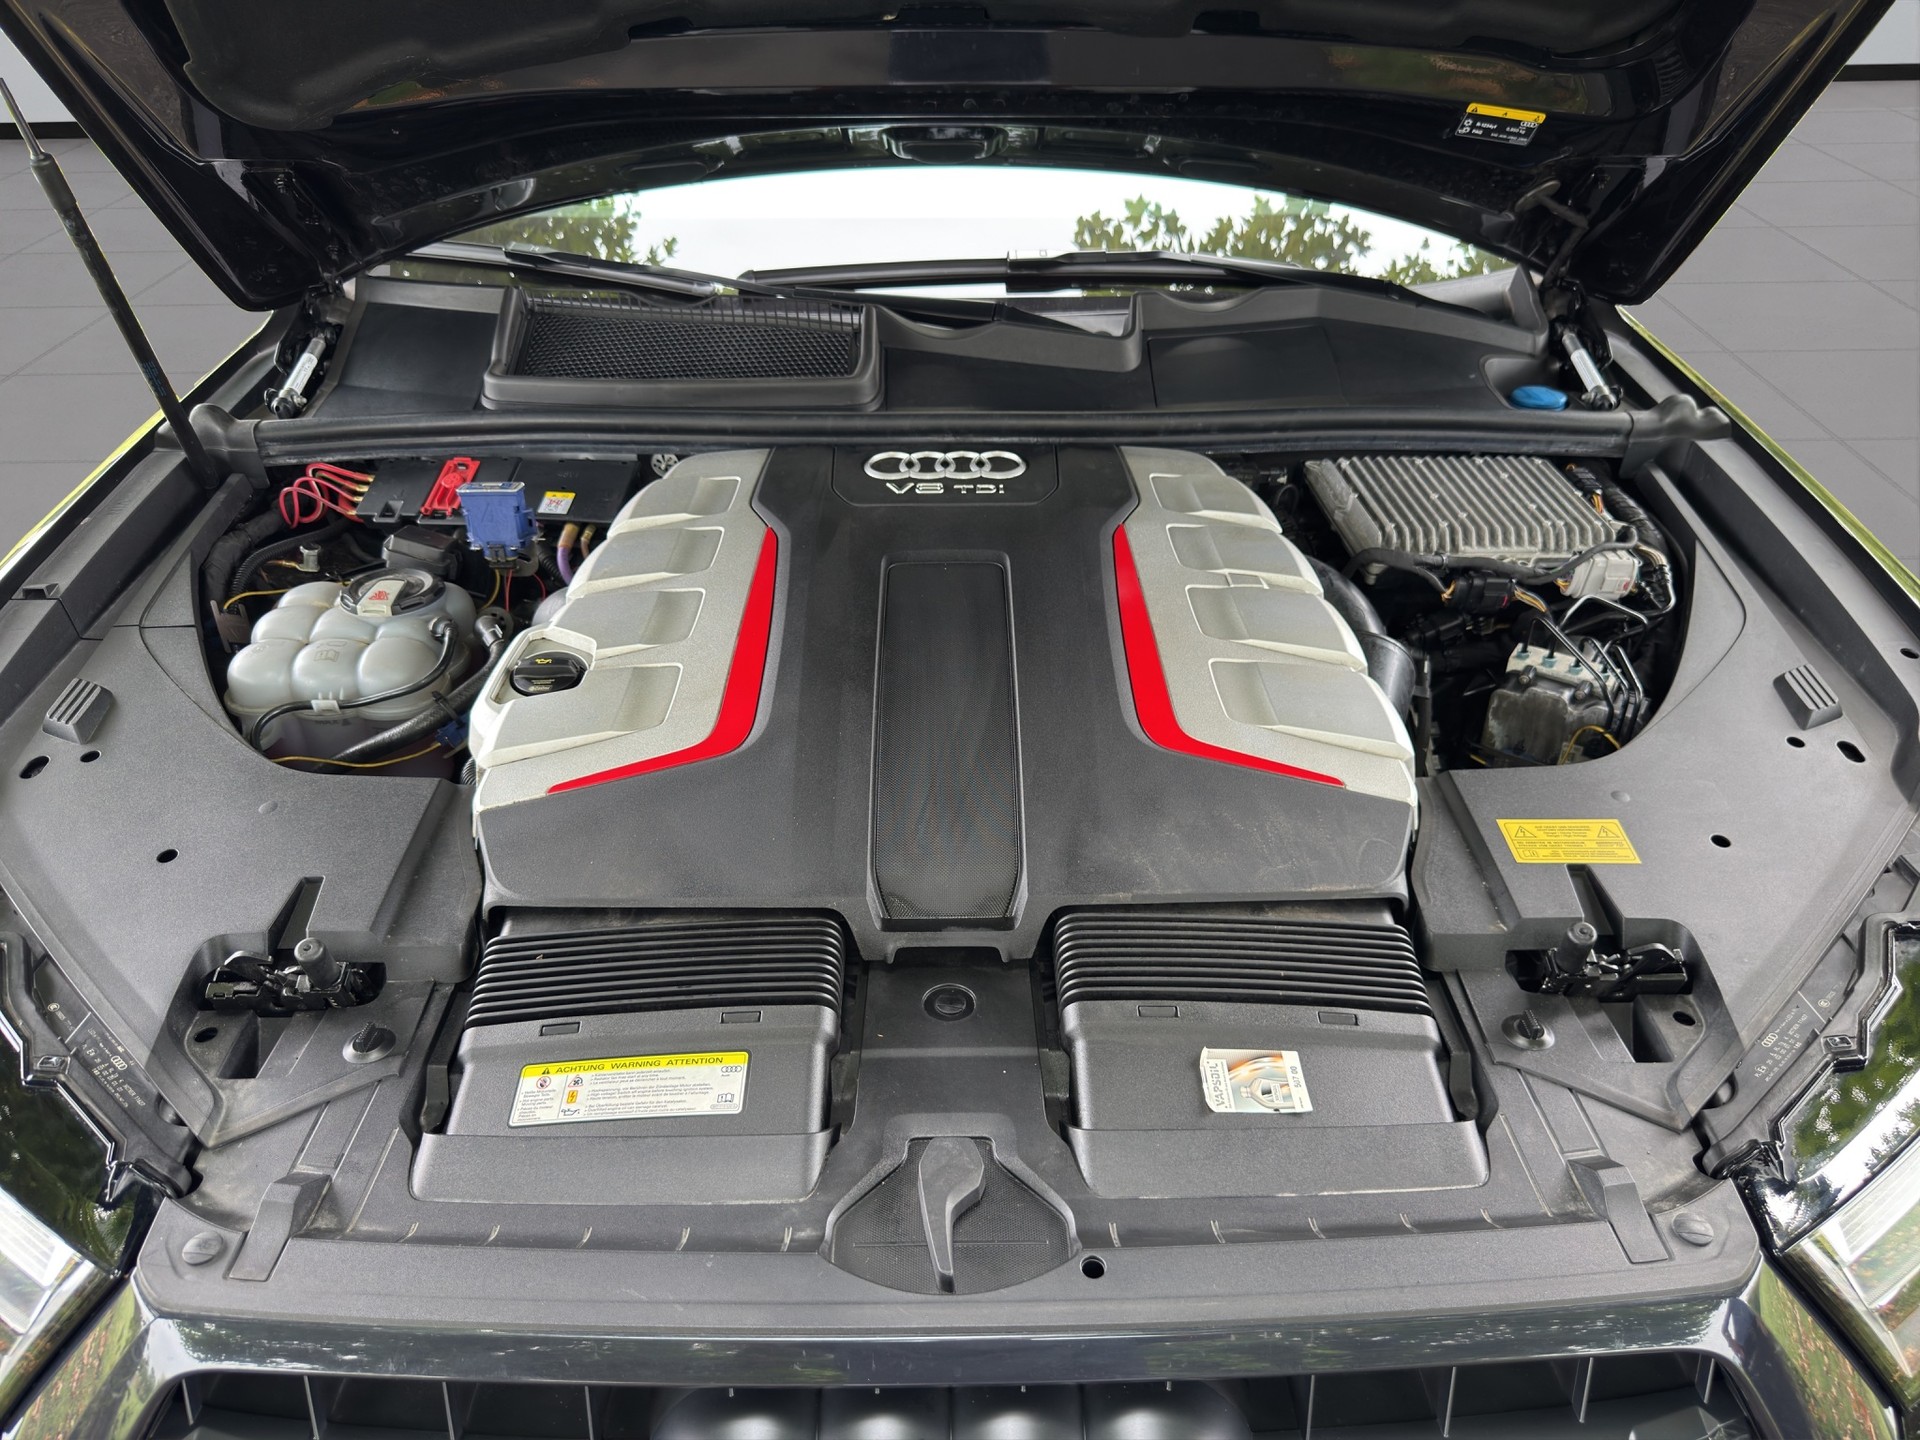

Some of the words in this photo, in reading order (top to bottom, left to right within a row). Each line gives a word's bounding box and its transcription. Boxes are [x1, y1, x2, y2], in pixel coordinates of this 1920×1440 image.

[886, 482, 944, 494] V8
[953, 484, 1005, 494] TDI
[555, 1063, 605, 1074] ACHTUNG
[611, 1060, 661, 1070] WARNING
[666, 1057, 723, 1067] ATTENTION
